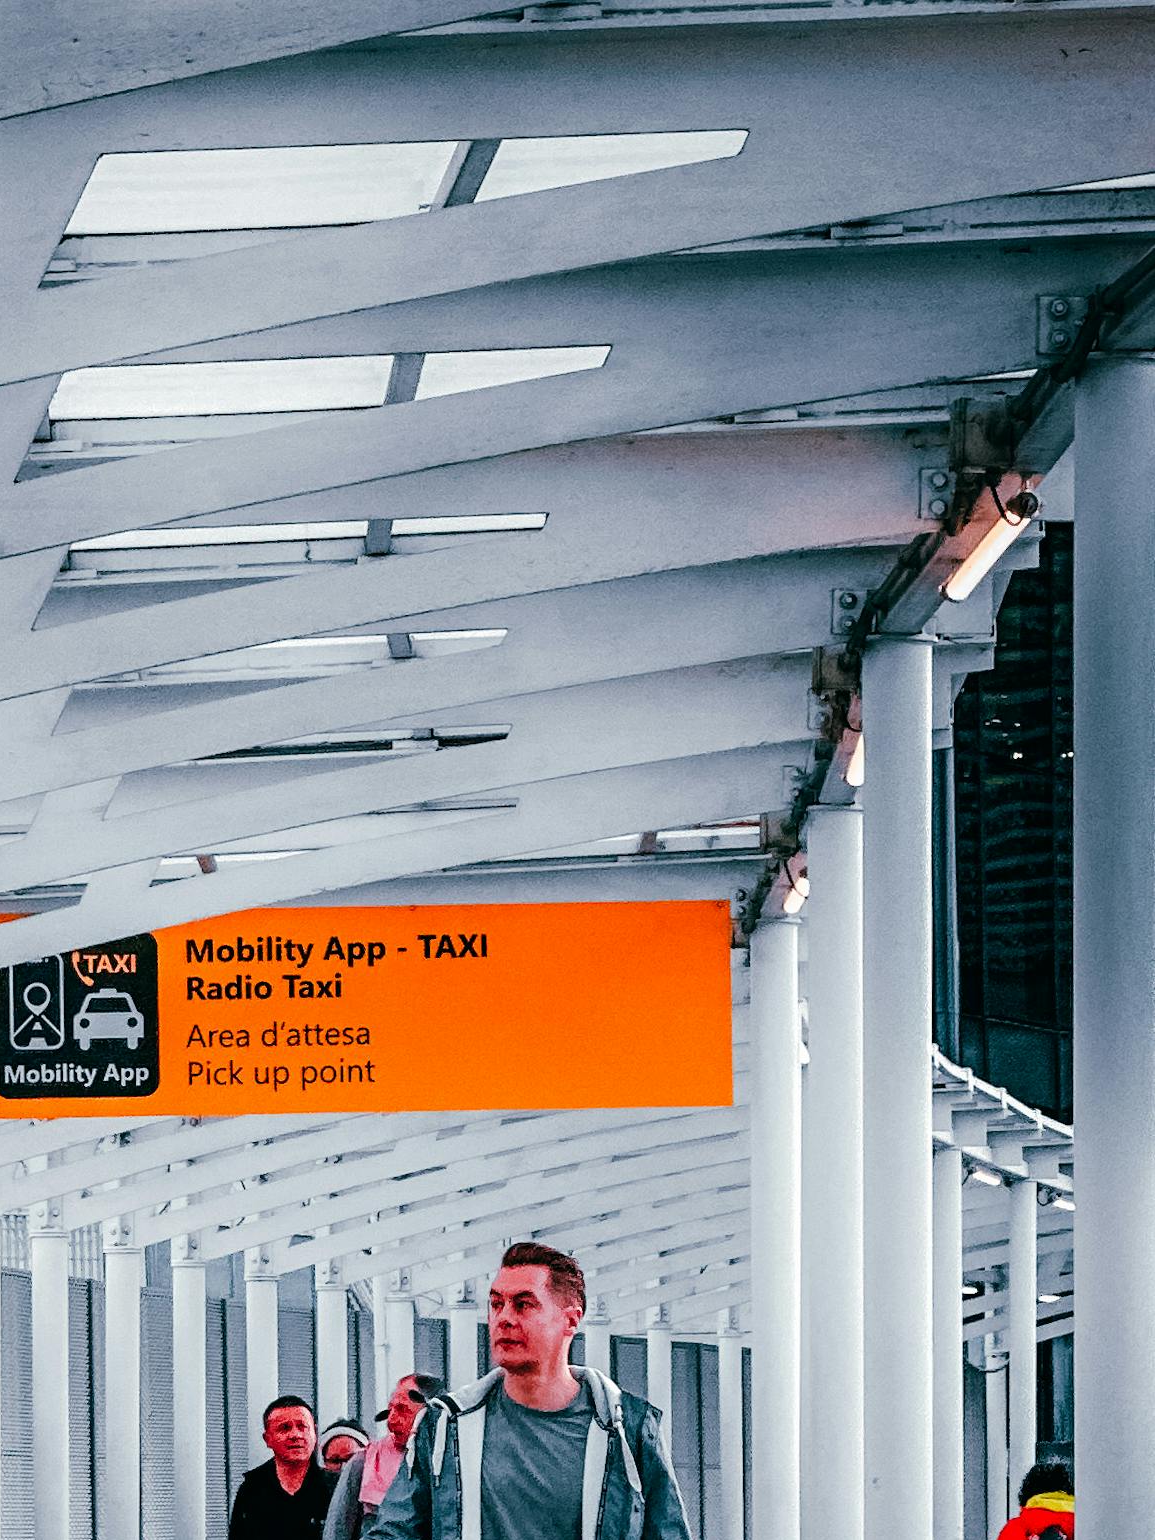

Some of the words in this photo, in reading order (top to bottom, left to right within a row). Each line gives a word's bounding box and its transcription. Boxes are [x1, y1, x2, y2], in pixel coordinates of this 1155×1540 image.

[83, 954, 137, 974] TAXI
[185, 936, 314, 968] Mobility
[323, 936, 387, 968] App
[417, 934, 488, 959] TAXI
[186, 974, 273, 1000] Radio
[282, 973, 342, 999] Taxi
[186, 1023, 251, 1049] Area
[4, 1063, 97, 1087] Mobility
[103, 1063, 150, 1087] App
[188, 1060, 244, 1086] Pick
[254, 1065, 290, 1092] up
[302, 1058, 376, 1092] point
